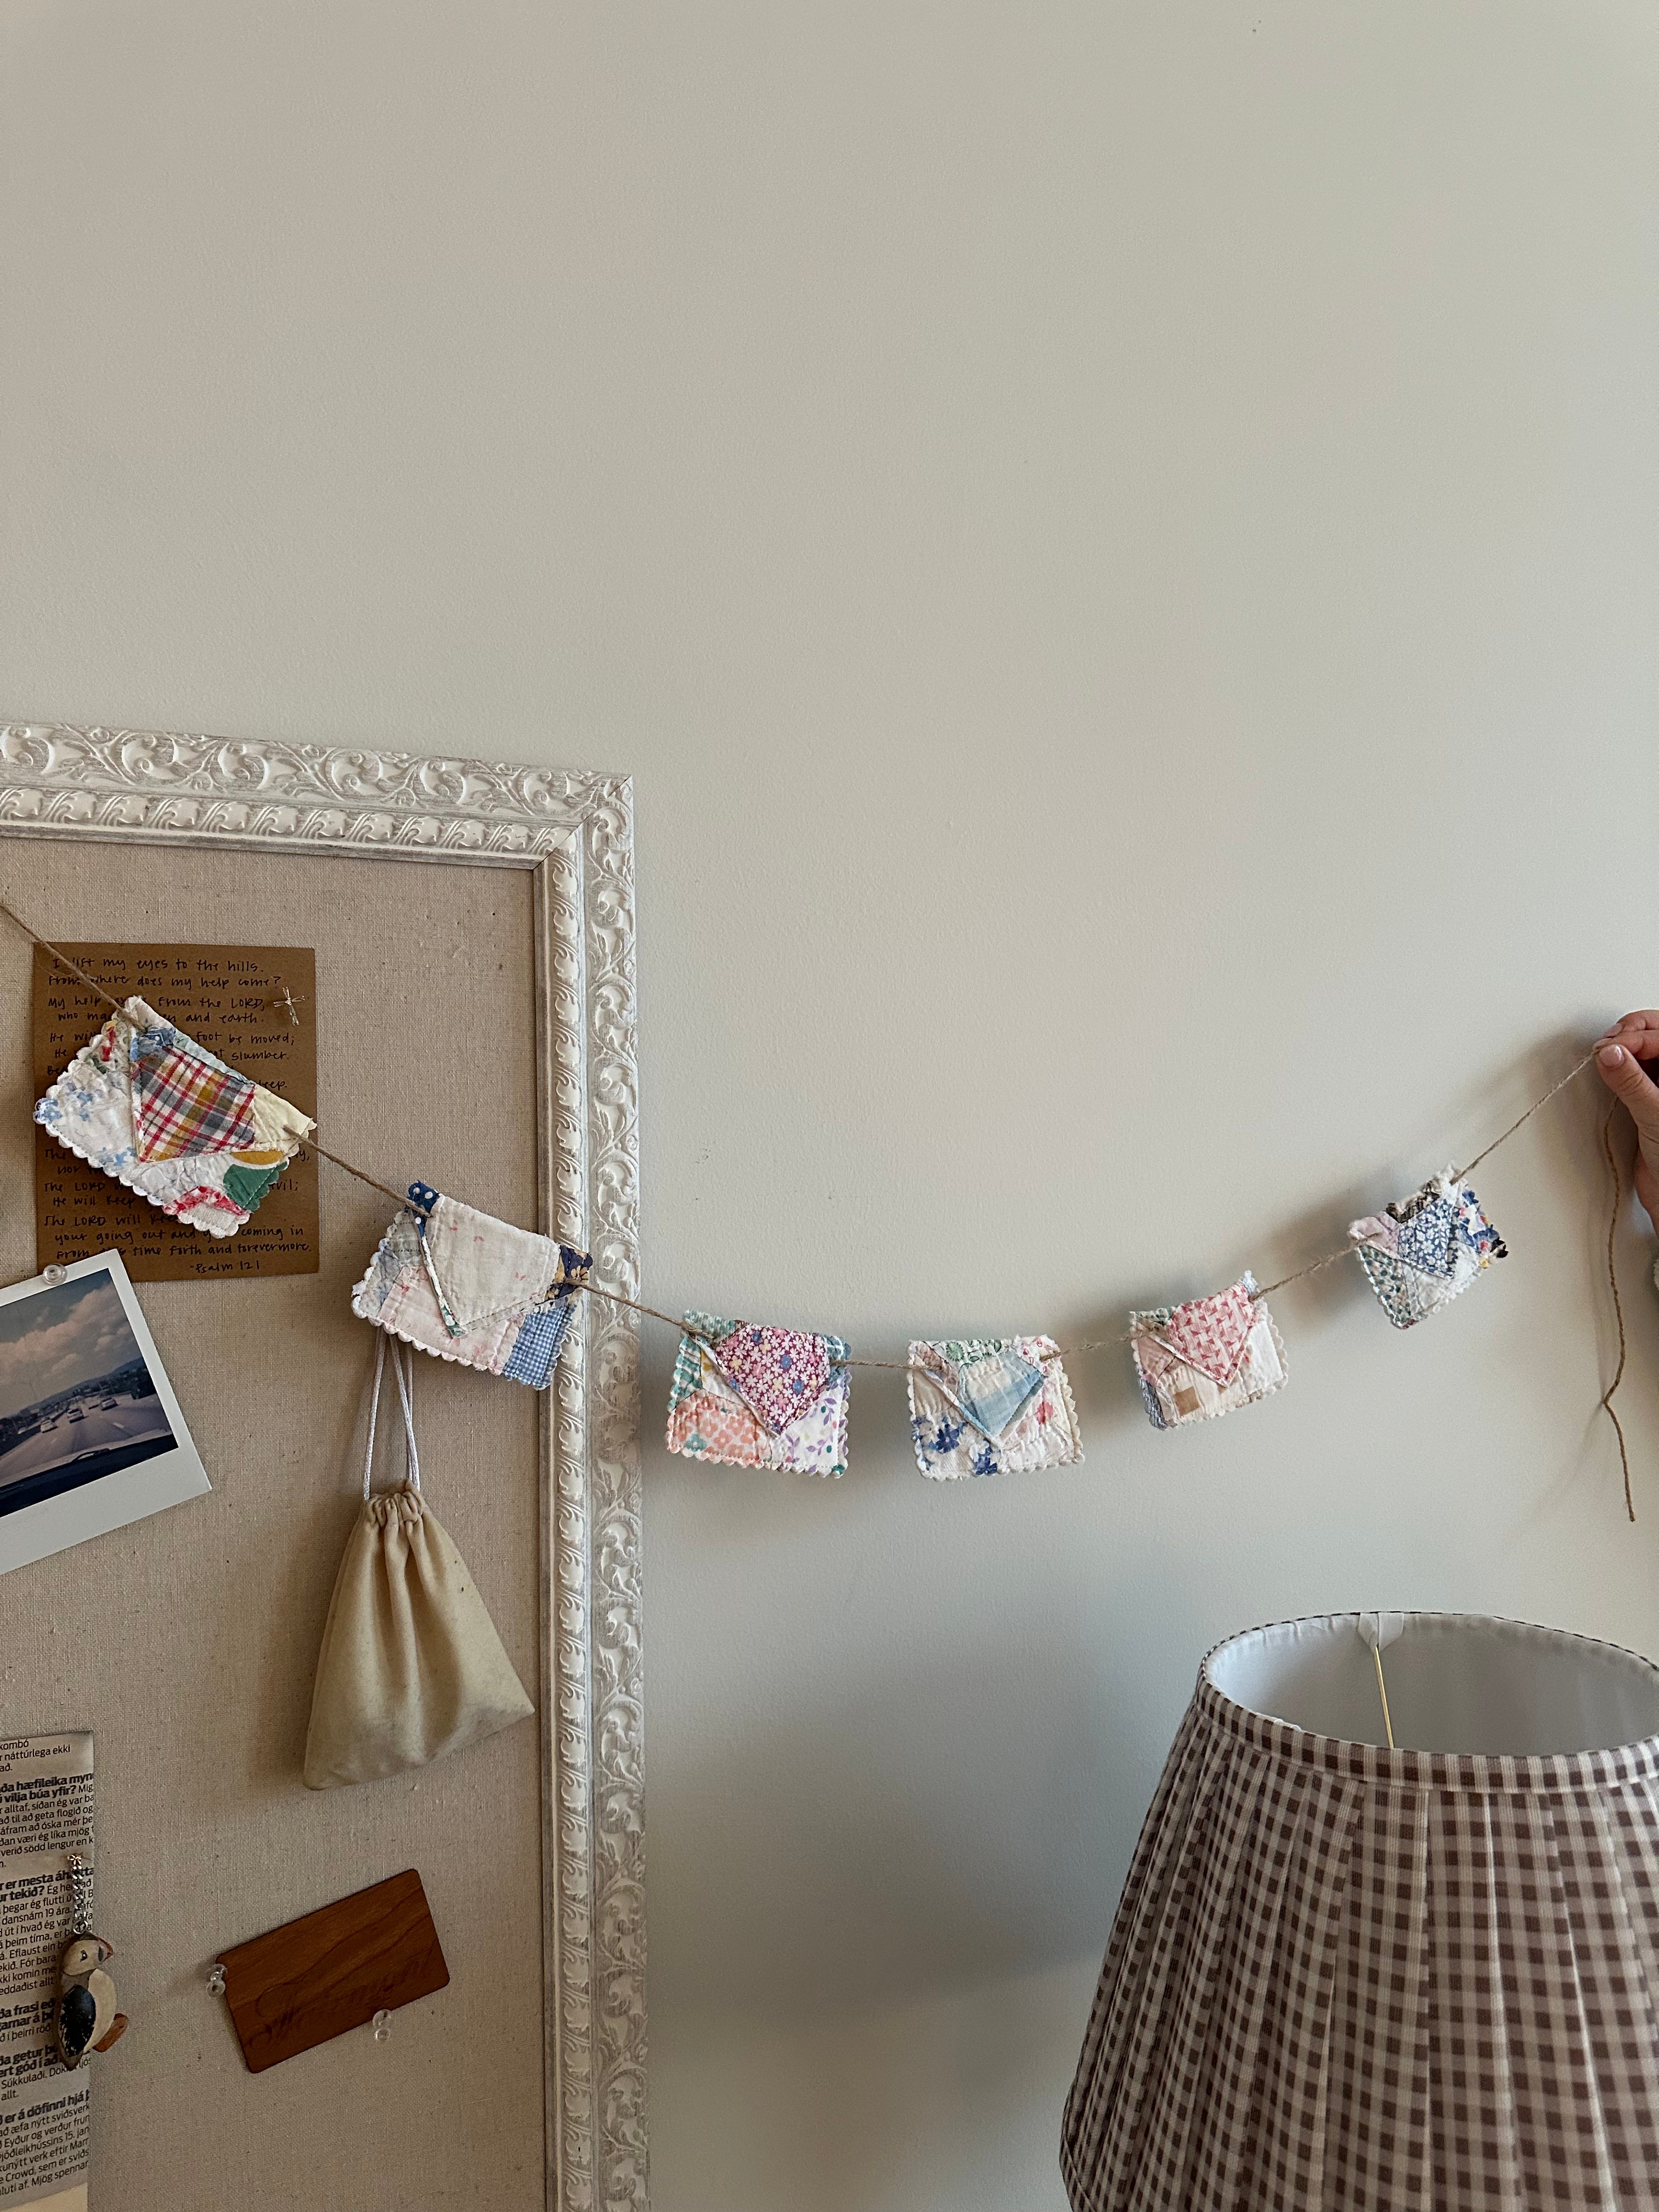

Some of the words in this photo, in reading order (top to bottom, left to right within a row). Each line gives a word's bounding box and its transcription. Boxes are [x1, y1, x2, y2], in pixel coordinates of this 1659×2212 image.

[52, 958, 60, 969] I
[103, 958, 126, 970] my
[137, 959, 168, 971] eyes
[175, 958, 188, 971] to
[196, 959, 219, 971] the
[228, 960, 264, 972] hills.
[137, 976, 162, 986] does
[171, 978, 191, 990] my
[201, 977, 229, 989] help
[238, 976, 282, 989] come?
[48, 997, 66, 1010] My
[75, 996, 101, 1007] help
[199, 998, 221, 1008] the
[230, 997, 266, 1011] LORD,
[58, 1012, 78, 1021] who
[185, 1012, 210, 1023] and
[219, 1012, 264, 1024] earth.
[49, 1032, 64, 1043] He
[229, 1033, 242, 1044] be
[251, 1032, 295, 1046] moved;
[54, 1047, 67, 1059] He
[231, 1050, 289, 1061] slumber.
[45, 1148, 66, 1160] The
[57, 1165, 81, 1175] nor
[44, 1182, 63, 1192] The
[74, 1182, 106, 1192] LORD
[53, 1197, 67, 1207] He
[74, 1194, 96, 1206] will
[44, 1215, 65, 1226] The
[74, 1215, 106, 1226] LORD
[115, 1214, 140, 1225] will
[54, 1232, 88, 1246] your
[96, 1230, 134, 1245] going
[142, 1229, 166, 1240] out
[171, 1228, 196, 1240] and
[241, 1224, 284, 1241] coming
[290, 1224, 304, 1237] in
[133, 1245, 162, 1256] time
[169, 1244, 202, 1256] forth
[208, 1243, 233, 1255] and
[4, 1748, 50, 1761] náttúrlega
[53, 1745, 71, 1754] ekki
[16, 1776, 67, 1791] hæfileika
[4, 1792, 28, 1803] vilja
[29, 1788, 50, 1800] búa
[52, 1785, 76, 1798] yfir?
[78, 1783, 93, 1793] Mig
[31, 1799, 55, 1810] síðan
[57, 1798, 67, 1808] ég
[69, 1797, 83, 1805] var
[12, 1814, 20, 1823] til
[22, 1813, 33, 1822] að
[35, 1811, 54, 1822] geta
[57, 1806, 81, 1818] flogið
[83, 1805, 93, 1814] og
[1, 1826, 26, 1836] áfram
[29, 1824, 40, 1832] að
[41, 1821, 62, 1830] óska
[64, 1818, 81, 1827] mér
[17, 1835, 36, 1844] væri
[38, 1832, 49, 1842] ég
[50, 1830, 66, 1839] líka
[67, 1827, 90, 1838] mjög
[1, 1846, 22, 1857] verið
[24, 1843, 46, 1854] södd
[47, 1841, 75, 1850] lengur
[76, 1838, 87, 1847] en
[5, 1880, 18, 1891] er
[18, 1874, 54, 1888] mesta
[9, 1885, 45, 1901] tekið?
[47, 1884, 59, 1895] Ég
[2, 1902, 29, 1916] þegar
[30, 1899, 41, 1910] ég
[42, 1894, 65, 1907] flutti
[2, 1911, 43, 1926] dansnám
[46, 1908, 54, 1918] 19
[5, 1927, 15, 1937] út
[16, 1925, 20, 1935] í
[20, 1922, 43, 1936] hvað
[44, 1920, 55, 1931] ég
[57, 1917, 71, 1927] var
[5, 1936, 28, 1950] þeim
[29, 1932, 52, 1944] tíma,
[54, 1931, 63, 1939] er
[9, 1945, 41, 1959] Eflaust
[42, 1943, 56, 1953] ein
[20, 1957, 35, 1969] Fór
[36, 1954, 57, 1966] bara
[13, 1967, 40, 1982] komin
[13, 2001, 40, 2016] frasi
[33, 2012, 40, 2023] á
[12, 2027, 35, 2041] þeirri
[36, 2024, 51, 2034] röð
[13, 2047, 44, 2065] getur
[15, 2059, 37, 2076] góð
[4, 2112, 16, 2124] er
[18, 2107, 26, 2121] á
[27, 2097, 67, 2119] döfinni
[67, 2090, 84, 2107] hjá
[10, 2121, 30, 2135] æfa
[31, 2115, 50, 2129] nýtt
[4, 2133, 30, 2148] Eyður
[31, 2130, 43, 2140] og
[44, 2121, 72, 2136] verður
[29, 2150, 48, 2164] verk
[49, 2145, 69, 2158] eftir
[38, 2160, 57, 2173] sem
[58, 2157, 67, 2166] er
[31, 2173, 53, 2187] Mjög
